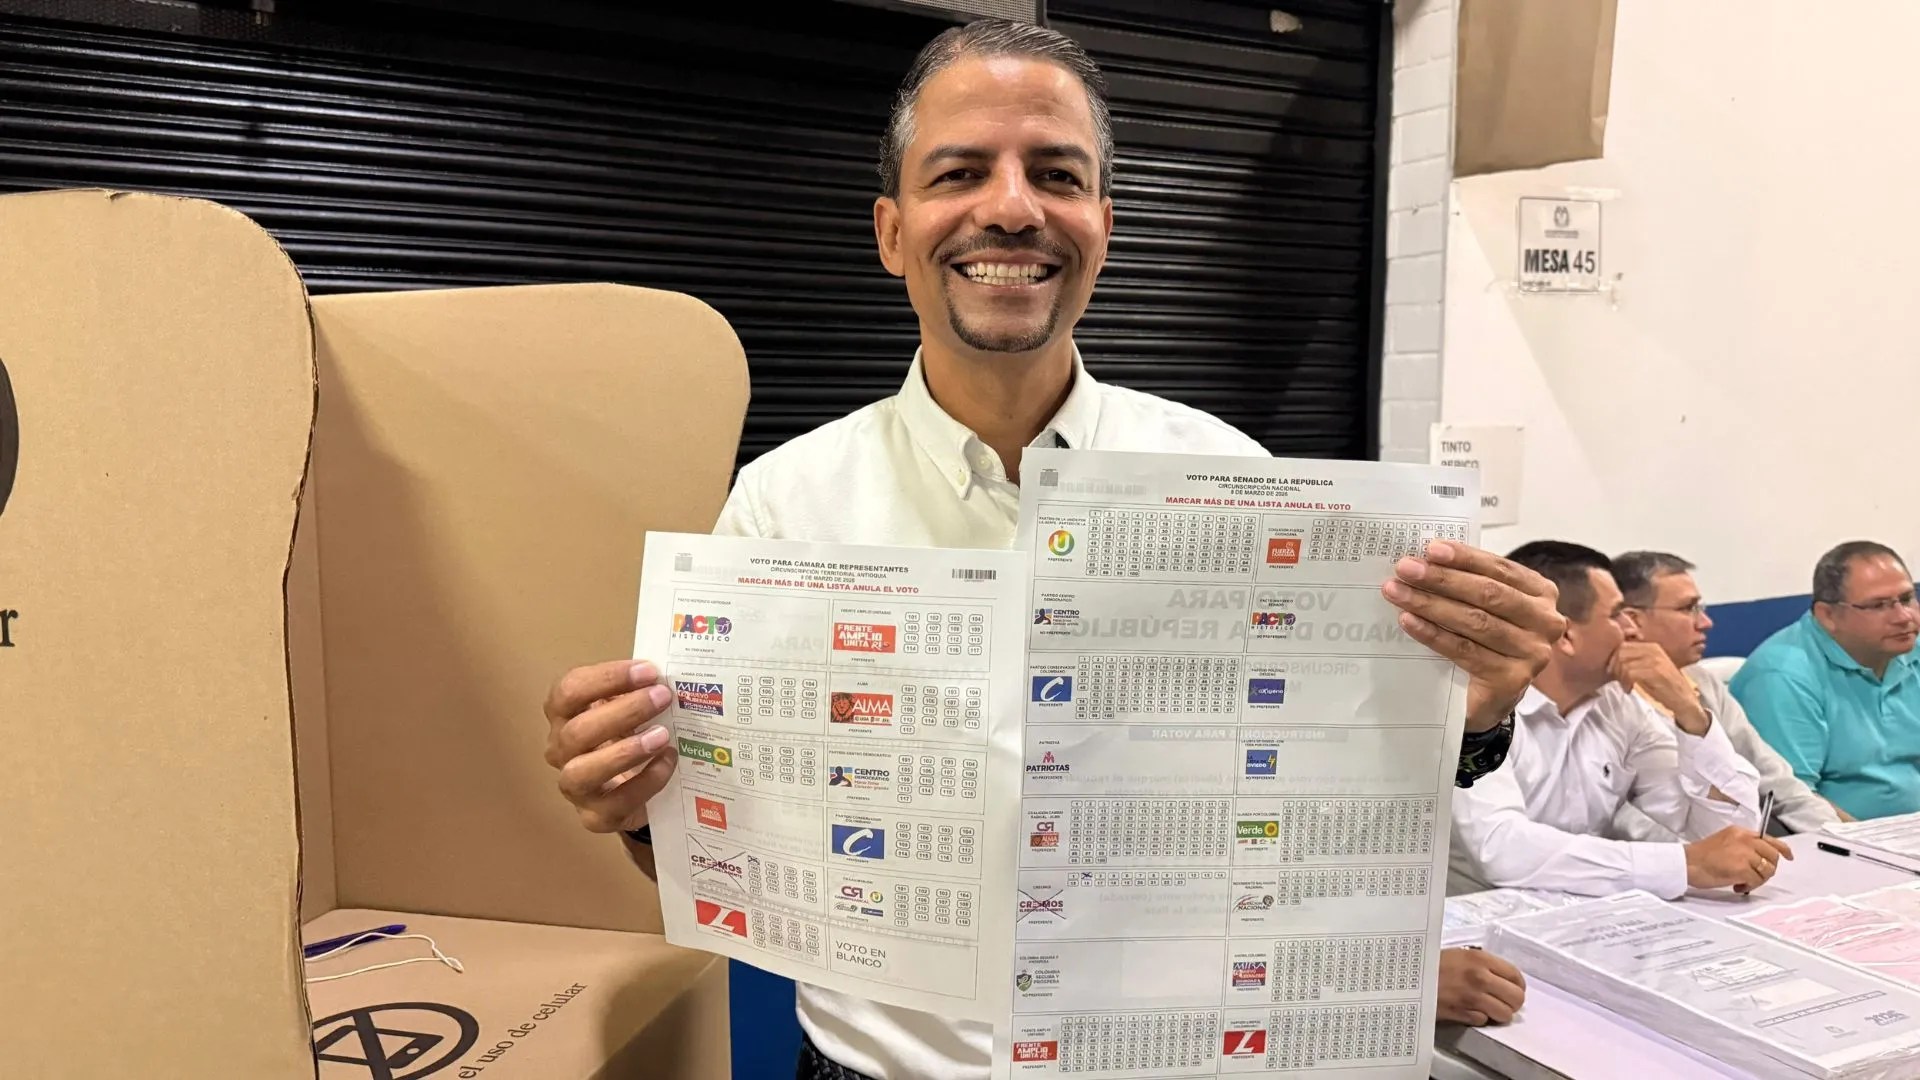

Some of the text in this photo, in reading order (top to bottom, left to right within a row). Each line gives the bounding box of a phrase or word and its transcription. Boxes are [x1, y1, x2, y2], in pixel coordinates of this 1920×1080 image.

[1524, 249, 1595, 274] MESA 45
[1441, 442, 1471, 453] TINTO
[1218, 482, 1269, 490] CIRCUNSCRIPCIÓN
[1290, 478, 1332, 486] REPÚBLICA
[1480, 496, 1498, 507] INO
[1054, 534, 1069, 552] U
[839, 563, 908, 572] REPRESENTANTES
[737, 577, 772, 585] MARCAR
[1252, 612, 1296, 625] PACTO
[672, 614, 732, 636] PACTO
[838, 624, 872, 632] FRENTE
[838, 630, 882, 641] AMPLIO
[678, 682, 722, 694] MIRA
[1040, 676, 1064, 701] C
[852, 698, 892, 715] ALMA
[680, 742, 712, 758] Verde
[854, 769, 890, 777] CENTRO
[1238, 826, 1263, 835] Verde
[843, 828, 873, 855] C
[836, 940, 886, 958] VOTO EN
[836, 952, 882, 968] BLANCO
[458, 982, 588, 1079] el uso de celular
